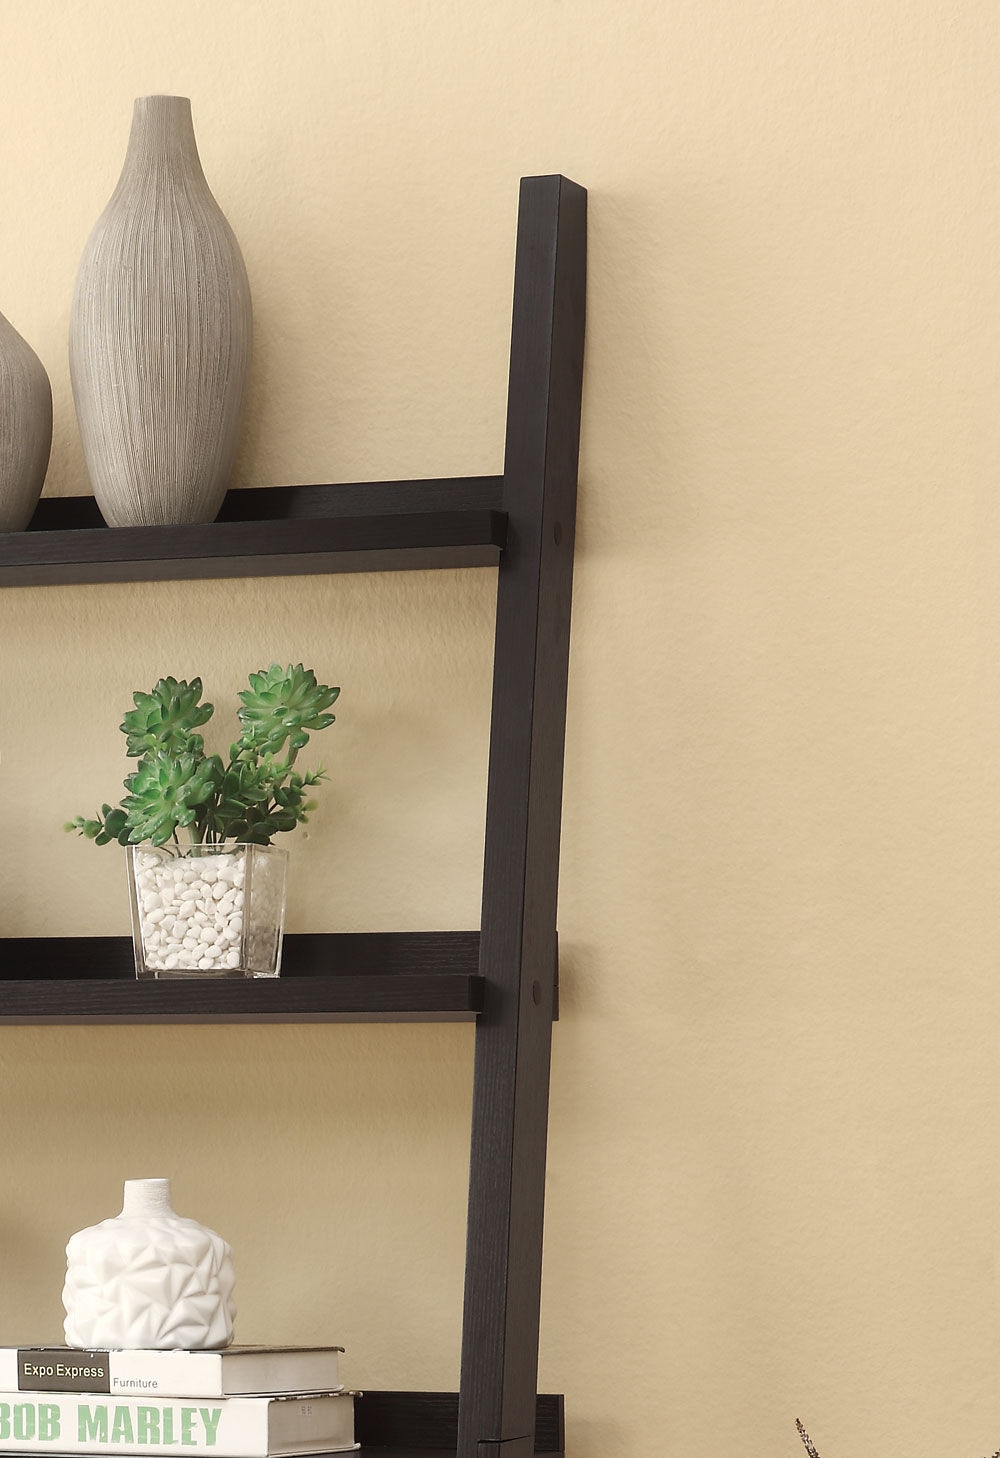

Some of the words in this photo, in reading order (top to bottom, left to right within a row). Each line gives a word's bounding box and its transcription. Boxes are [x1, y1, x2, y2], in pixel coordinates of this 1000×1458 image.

[23, 1363, 54, 1378] Expo
[56, 1364, 105, 1379] Express
[113, 1377, 158, 1389] Furniture
[77, 1404, 222, 1446] MARLEY
